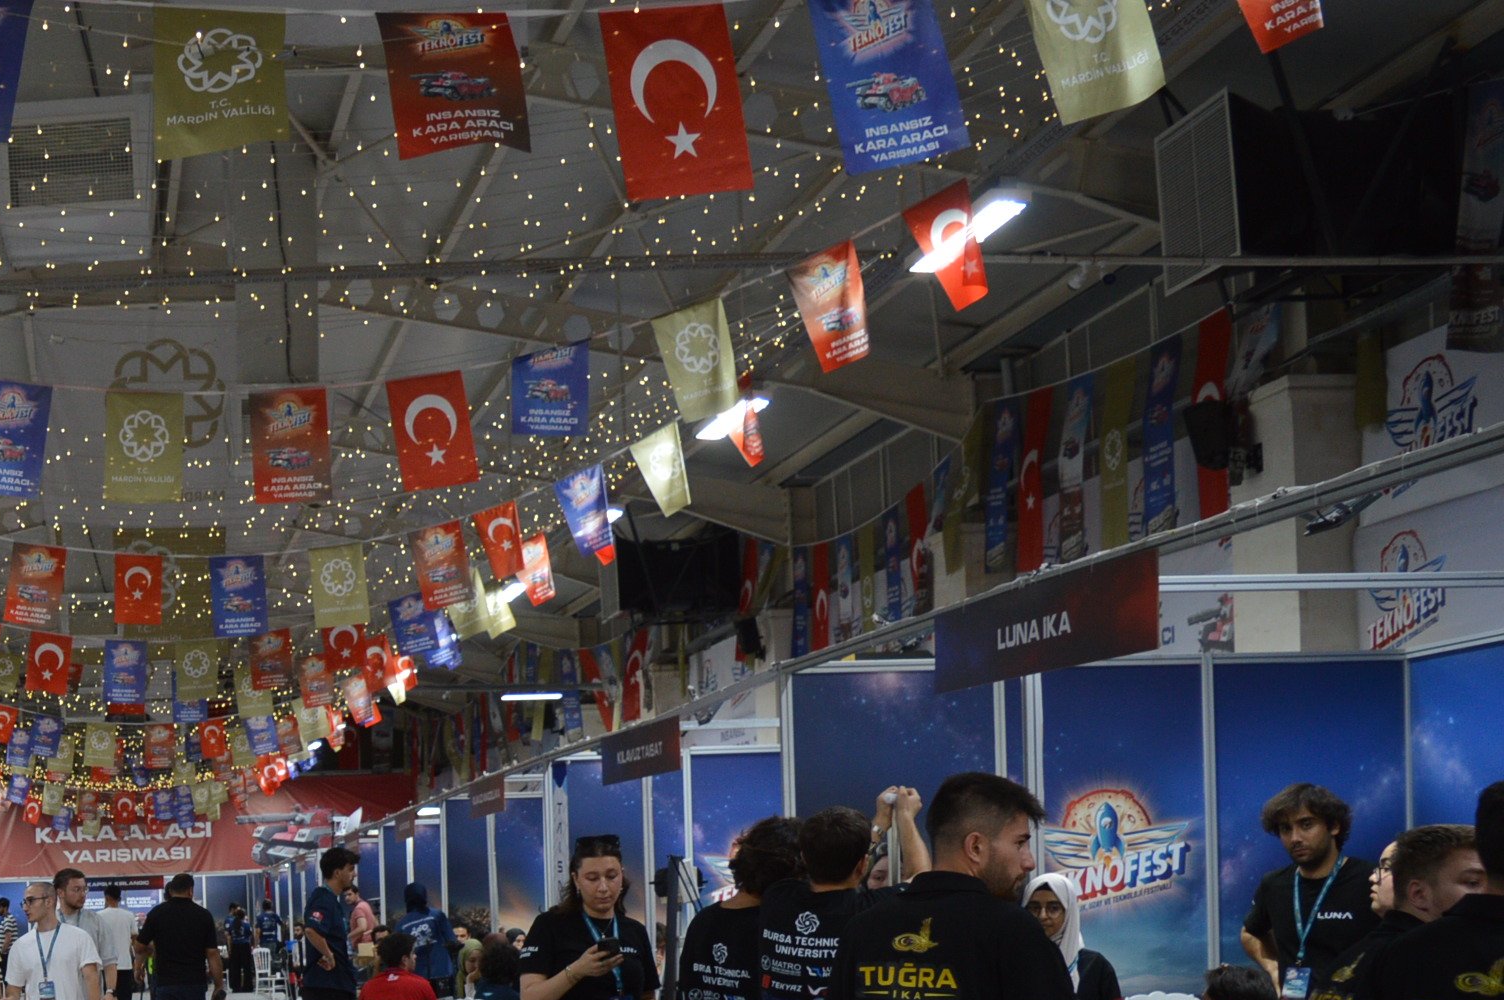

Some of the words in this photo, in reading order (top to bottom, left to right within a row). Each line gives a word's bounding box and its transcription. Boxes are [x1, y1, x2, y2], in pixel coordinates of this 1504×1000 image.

[1265, 6, 1307, 30] KARA
[850, 13, 908, 52] TEKNOFEST
[418, 33, 486, 52] TEKNOFEST
[426, 109, 500, 121] INSANSIZ
[412, 122, 460, 138] KARA
[465, 119, 514, 131] ARACI
[865, 116, 933, 138] INSANSIZ
[854, 138, 897, 154] KARA
[900, 125, 948, 145] ARACI
[0, 477, 30, 486] ARACI
[263, 484, 291, 492] KARA
[293, 482, 322, 490] ARACI
[997, 619, 1039, 650] LUNA
[1042, 611, 1072, 639] IKA
[35, 823, 117, 844] KARA
[63, 847, 191, 864] YARIŞMASI
[1067, 842, 1191, 902] KNOFEST
[1317, 911, 1353, 919] LUNA
[763, 928, 792, 944] BURSA
[775, 944, 837, 959] UNIVERSITY
[859, 962, 958, 988] TUĞRA
